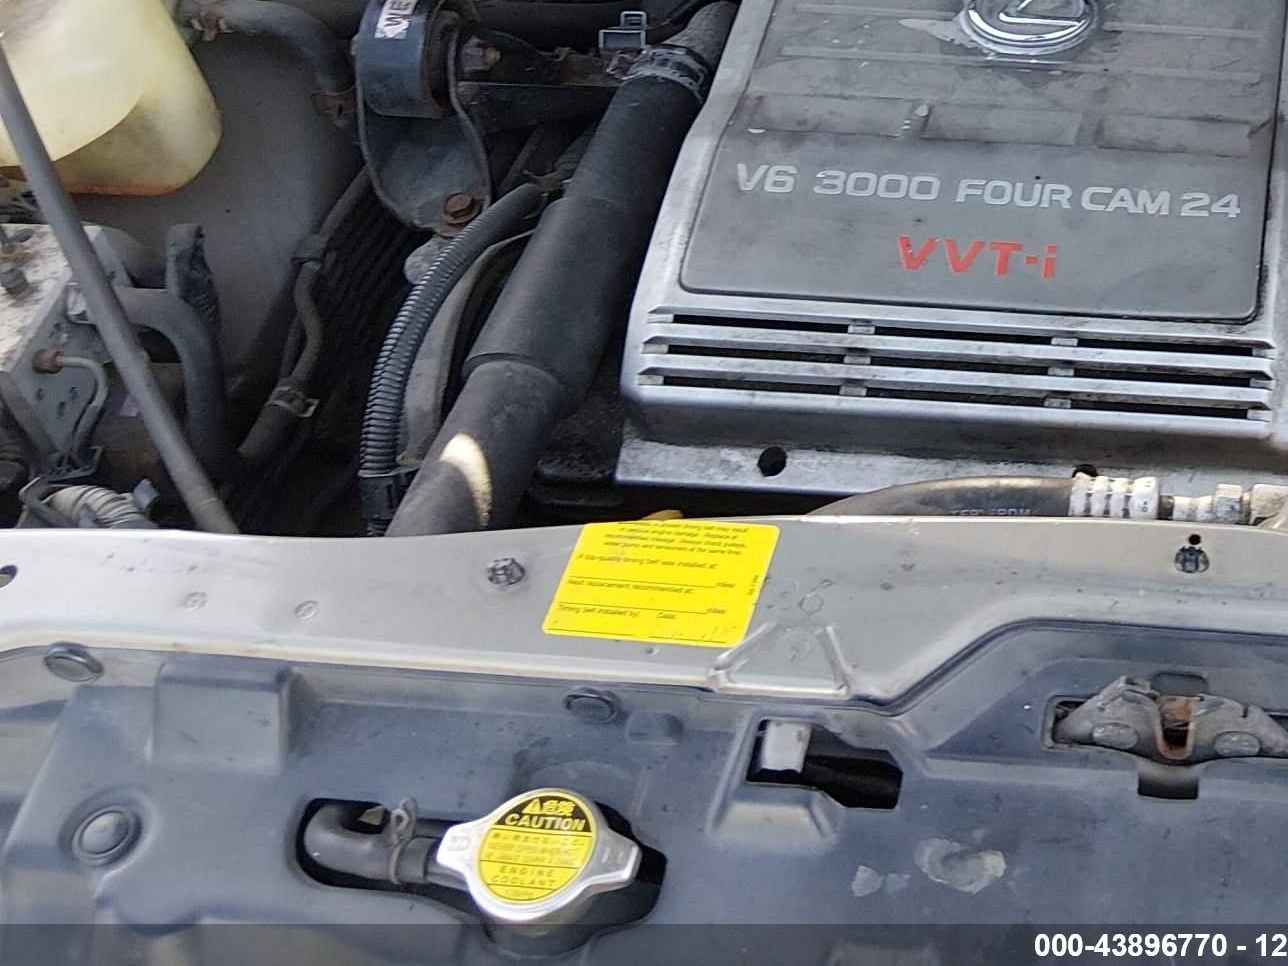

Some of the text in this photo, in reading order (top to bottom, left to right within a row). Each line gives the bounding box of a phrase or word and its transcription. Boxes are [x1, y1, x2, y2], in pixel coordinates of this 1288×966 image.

[736, 162, 1242, 219] V6 3000 FOUR CAM 24
[505, 813, 586, 832] CAUTION
